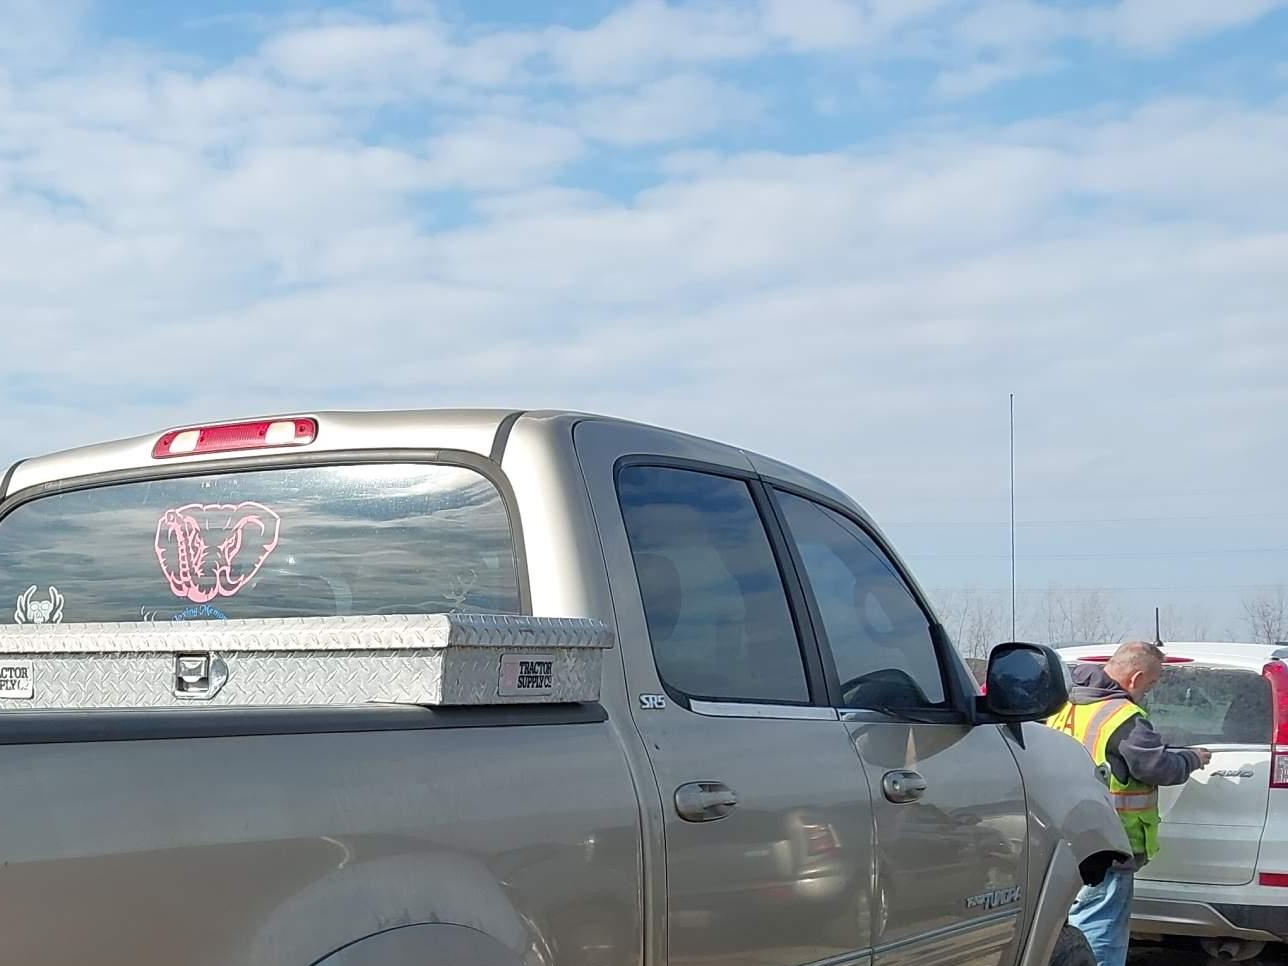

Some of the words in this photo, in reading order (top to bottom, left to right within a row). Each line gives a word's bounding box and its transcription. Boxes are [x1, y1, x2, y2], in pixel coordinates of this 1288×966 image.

[519, 661, 553, 675] TRACTOR
[516, 675, 544, 689] SUPPLY
[639, 694, 666, 710] SR5
[1209, 768, 1255, 779] AWD
